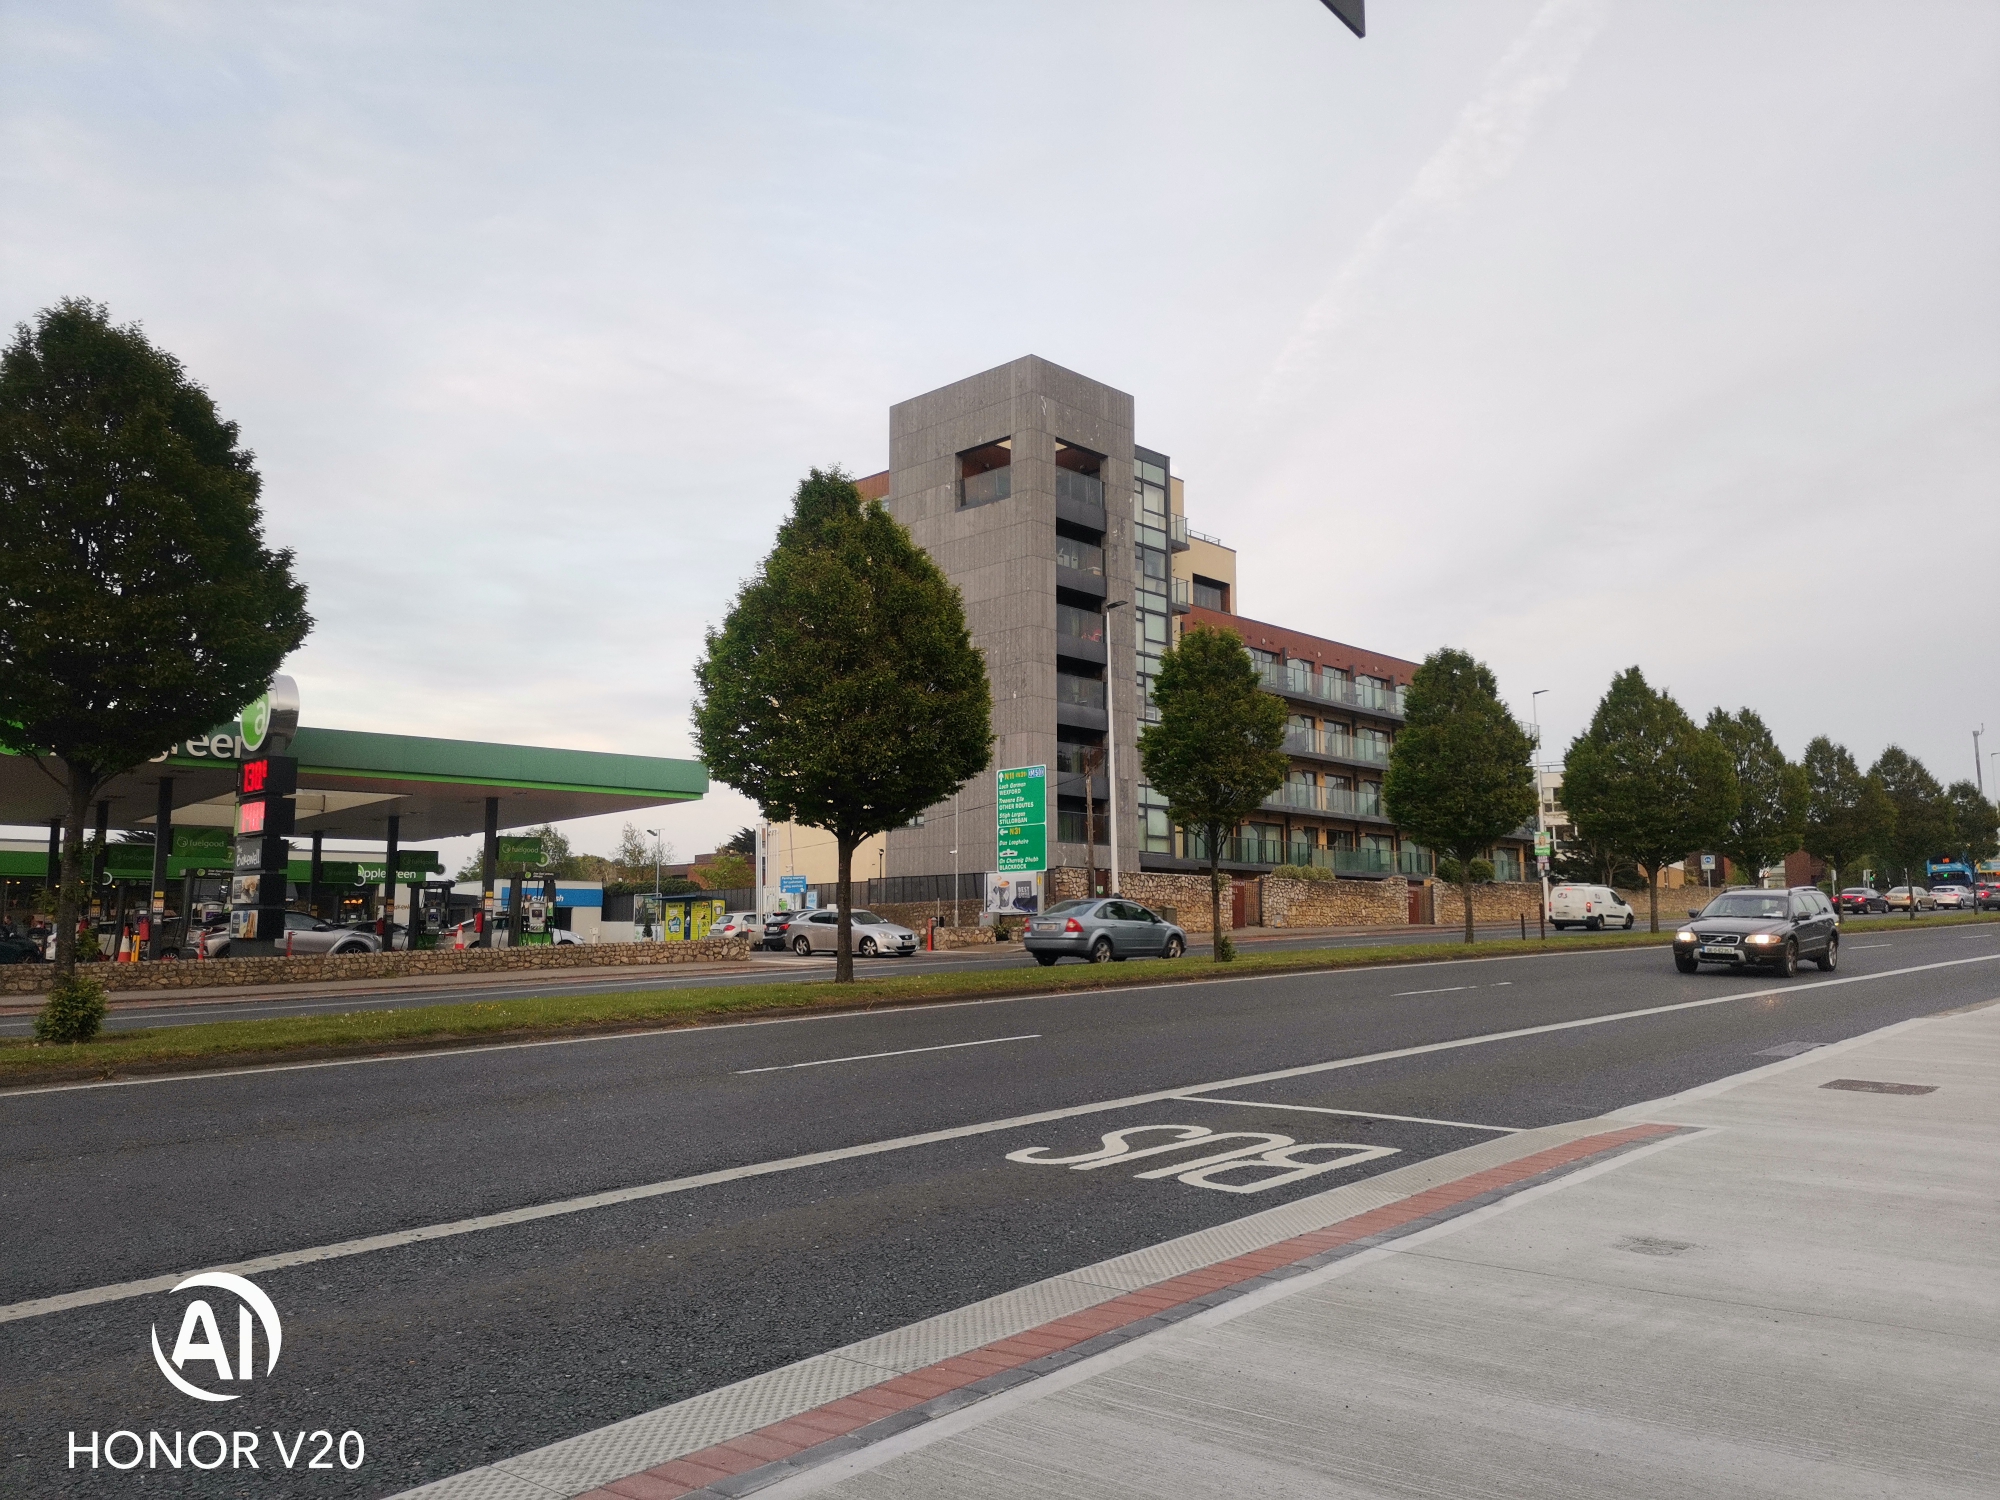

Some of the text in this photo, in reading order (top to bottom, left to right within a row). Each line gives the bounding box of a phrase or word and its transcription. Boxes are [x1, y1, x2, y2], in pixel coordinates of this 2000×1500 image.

[1004, 772, 1015, 780] N11
[999, 803, 1015, 811] OTHER
[999, 817, 1028, 825] STILLORGAN
[1009, 827, 1021, 835] N31
[189, 838, 225, 849] fuelgood
[511, 847, 539, 855] fuelgood
[999, 863, 1027, 871] BLACKROCK
[1004, 1123, 1403, 1194] BUS
